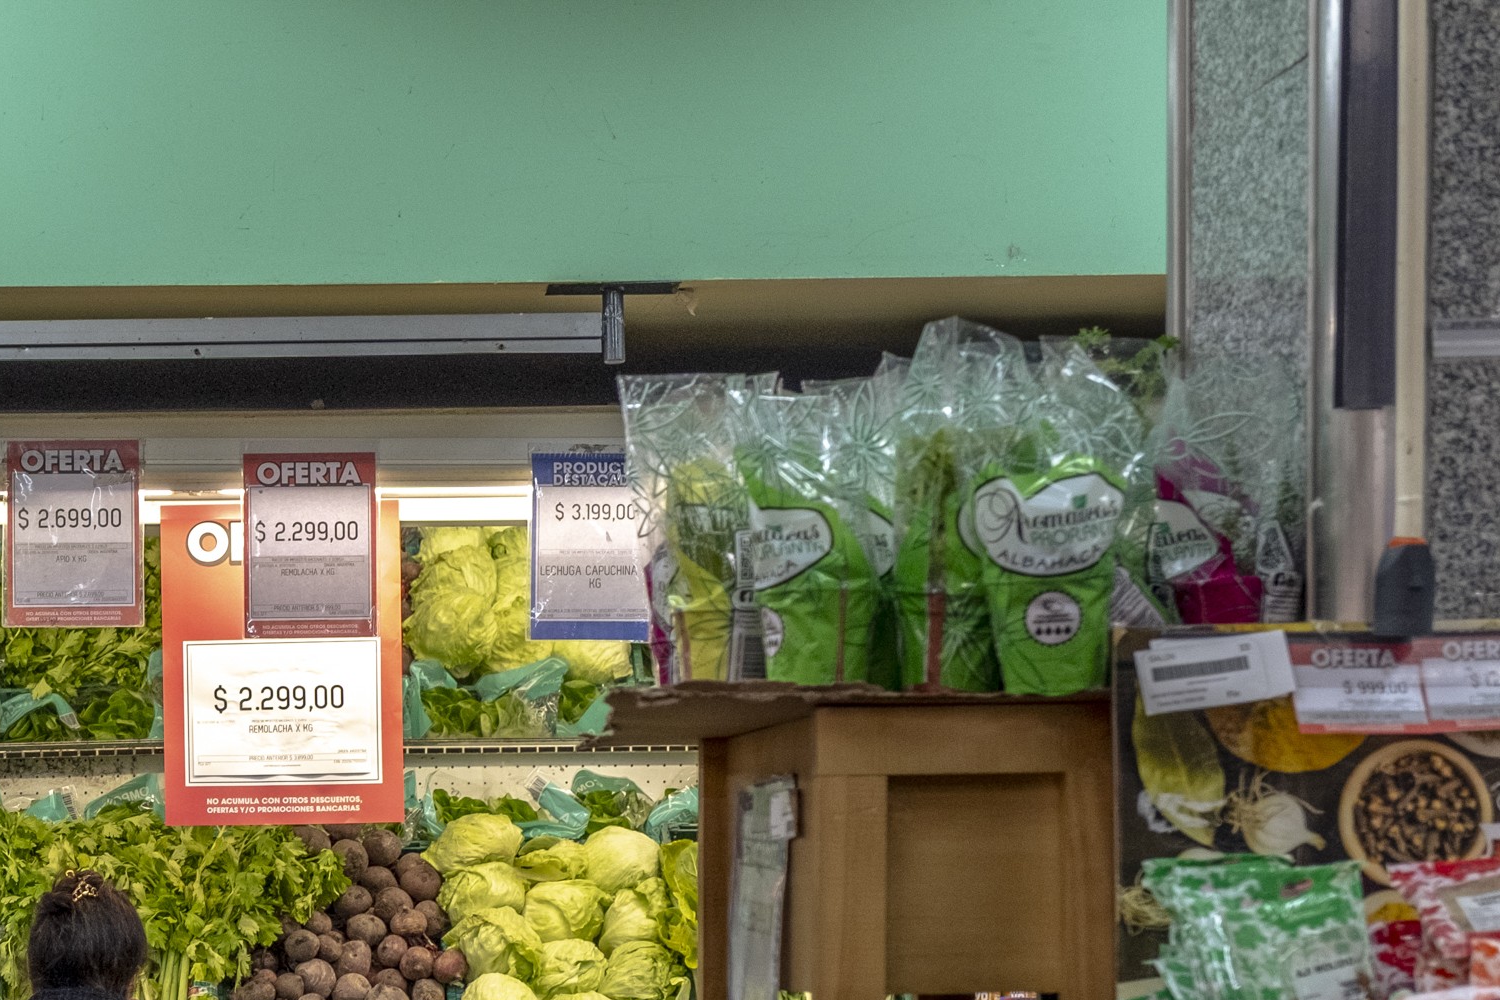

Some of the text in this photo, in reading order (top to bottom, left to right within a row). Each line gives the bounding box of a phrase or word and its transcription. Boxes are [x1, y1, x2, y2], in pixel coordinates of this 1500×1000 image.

[20, 449, 125, 474] OFERTA
[256, 461, 362, 486] OFERTA
[553, 474, 628, 486] DESTACAD
[17, 507, 123, 531] $ 2.699,00
[555, 502, 565, 521] $
[255, 520, 266, 544] $
[275, 521, 359, 544] 2.299,00
[281, 568, 318, 576] REMOLACHA
[540, 565, 638, 576] LECHUGA CAPUCHINA
[589, 578, 602, 589] KG
[1311, 648, 1396, 668] OFERTA
[1442, 641, 1500, 661] OFER
[1343, 680, 1352, 694] $
[214, 684, 345, 714] $ 2.299,00
[249, 723, 313, 733] REMOLACHA X KG
[221, 797, 260, 805] ACUMULA
[282, 796, 309, 804] OTROS
[310, 796, 363, 804] DESCUENTOS,
[207, 806, 239, 814] OFERTAS
[257, 805, 314, 813] PROMOCIONES
[316, 804, 360, 812] BANCARIAS
